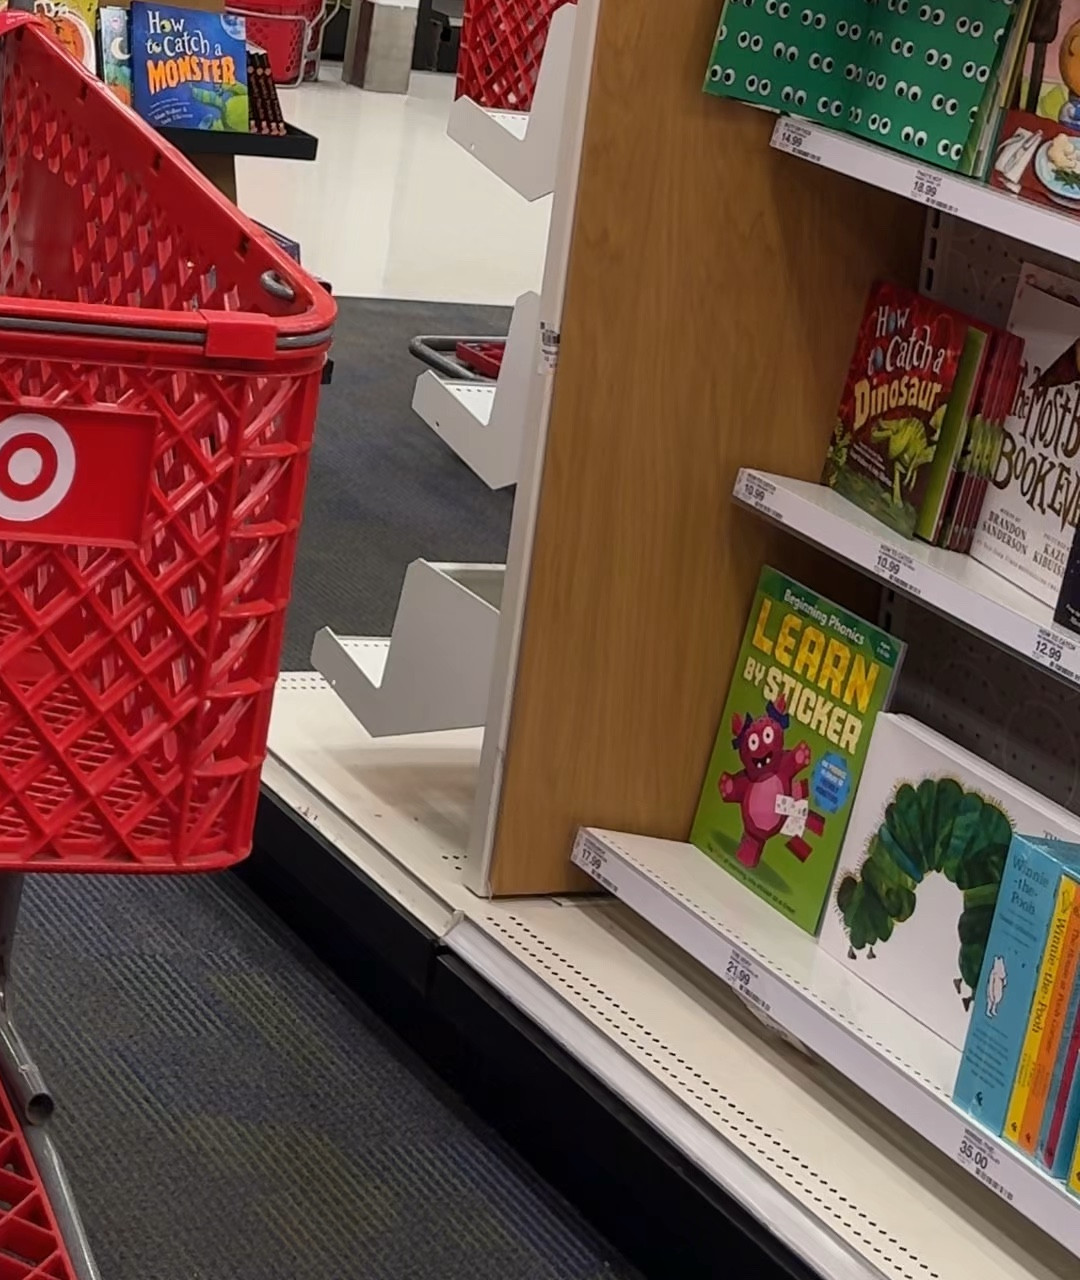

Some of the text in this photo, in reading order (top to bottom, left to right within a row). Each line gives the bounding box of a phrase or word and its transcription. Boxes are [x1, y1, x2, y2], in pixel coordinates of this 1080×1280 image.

[147, 10, 184, 33] How
[145, 38, 162, 54] to
[214, 43, 222, 56] a
[146, 55, 236, 96] MONSTER
[781, 132, 803, 148] 14.99
[913, 180, 937, 198] 18.99
[876, 305, 910, 338] How
[868, 325, 946, 376] to Catch a
[853, 375, 943, 432] Dinosaur
[744, 483, 765, 502] 10.99
[982, 520, 1027, 555] SANDERSON
[988, 510, 1026, 541] BRANDON
[877, 554, 900, 575] 10.99
[783, 589, 865, 645] Beginning Phonics
[752, 598, 880, 714] LEARN
[1034, 640, 1063, 662] 12.99
[743, 656, 863, 755] BY STICKER
[581, 848, 602, 869] 17.99
[1012, 855, 1049, 888] Winnie
[1010, 891, 1035, 916] Pooh
[726, 960, 751, 986] 21.99
[959, 1140, 988, 1170] 35.00
